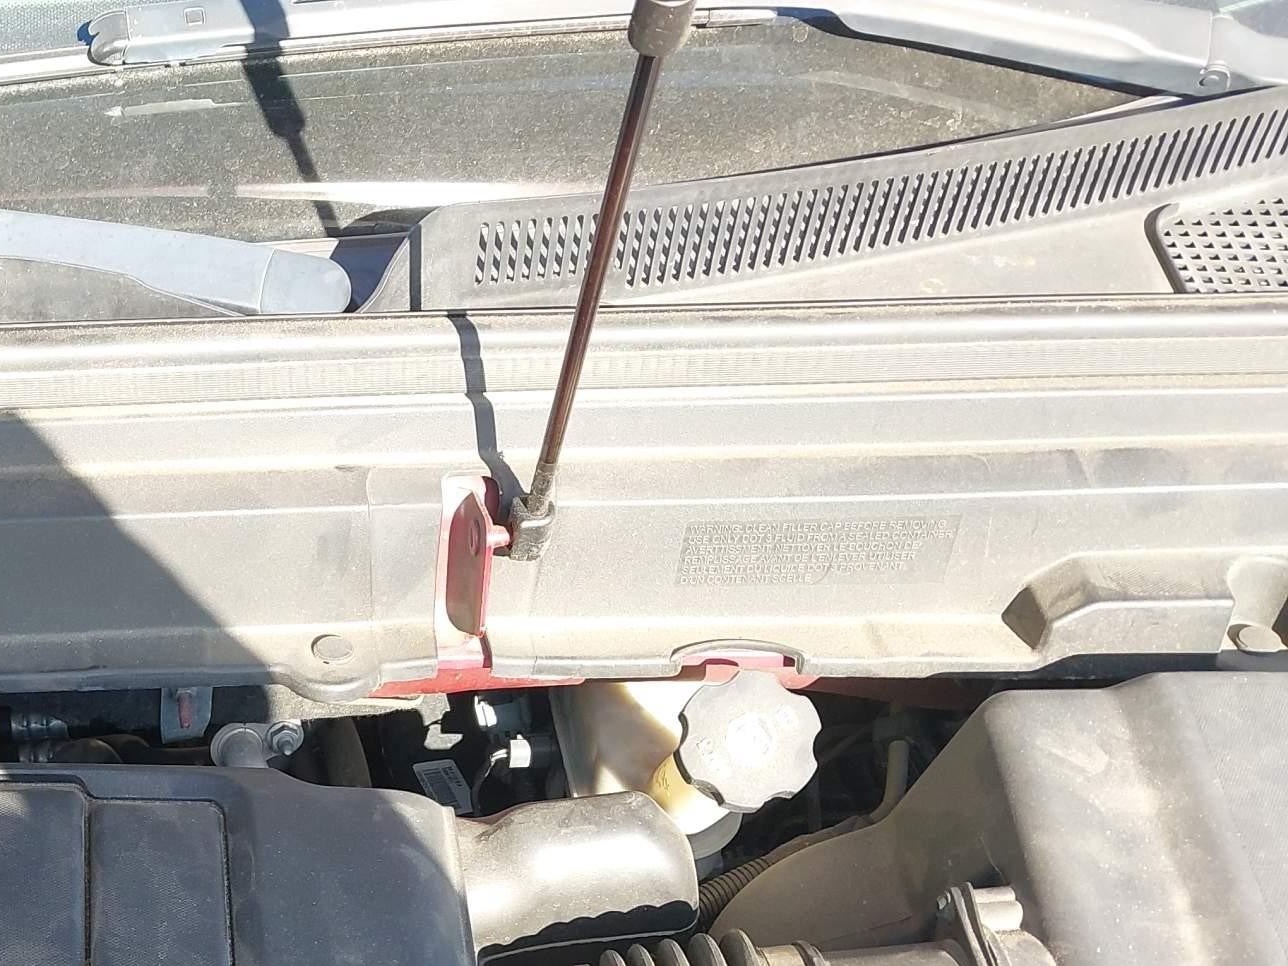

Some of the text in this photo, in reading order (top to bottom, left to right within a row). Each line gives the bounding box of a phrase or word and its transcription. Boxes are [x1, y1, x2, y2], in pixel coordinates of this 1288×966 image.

[782, 522, 818, 532] FILLER
[820, 521, 842, 531] CAP
[844, 520, 888, 531] BEFORE
[688, 534, 710, 545] USE
[712, 534, 741, 544] ONLY
[742, 534, 765, 544] DOT
[775, 533, 806, 543] FLUID
[807, 532, 838, 542] FROM
[847, 531, 890, 541] SEALED
[760, 553, 793, 564] AVANT
[794, 553, 809, 563] DE
[868, 551, 916, 561] UTILISER
